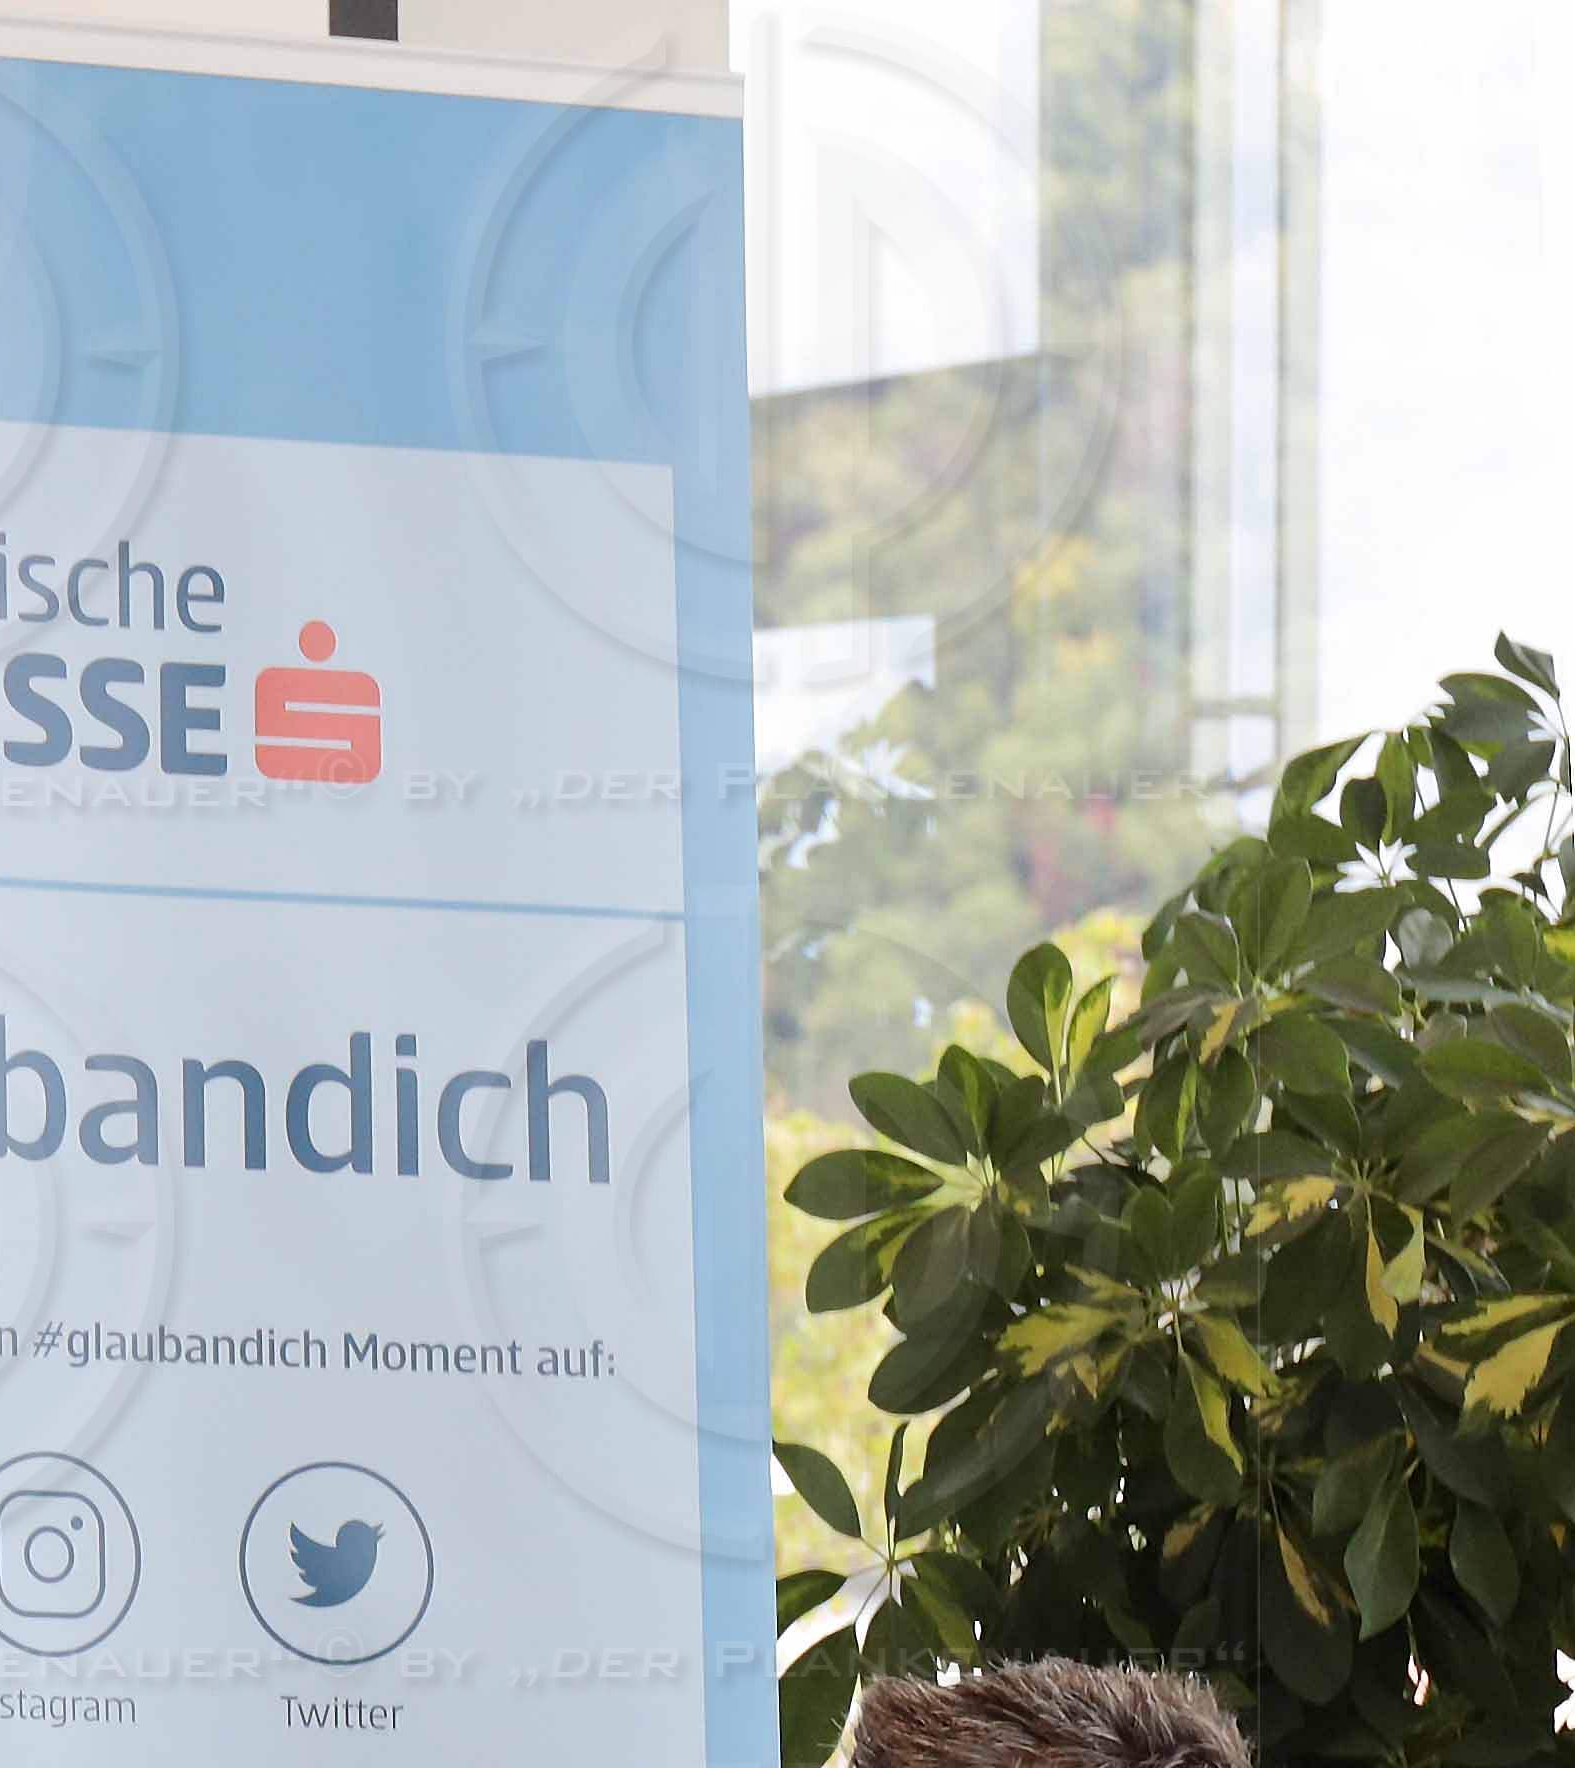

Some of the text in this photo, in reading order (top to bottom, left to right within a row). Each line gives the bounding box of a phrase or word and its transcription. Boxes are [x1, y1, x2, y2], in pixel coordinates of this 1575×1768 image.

[31, 1319, 328, 1373] #glaubandich
[343, 1332, 523, 1376] Moment
[536, 1335, 618, 1380] auf:
[280, 1691, 405, 1732] Twitter
